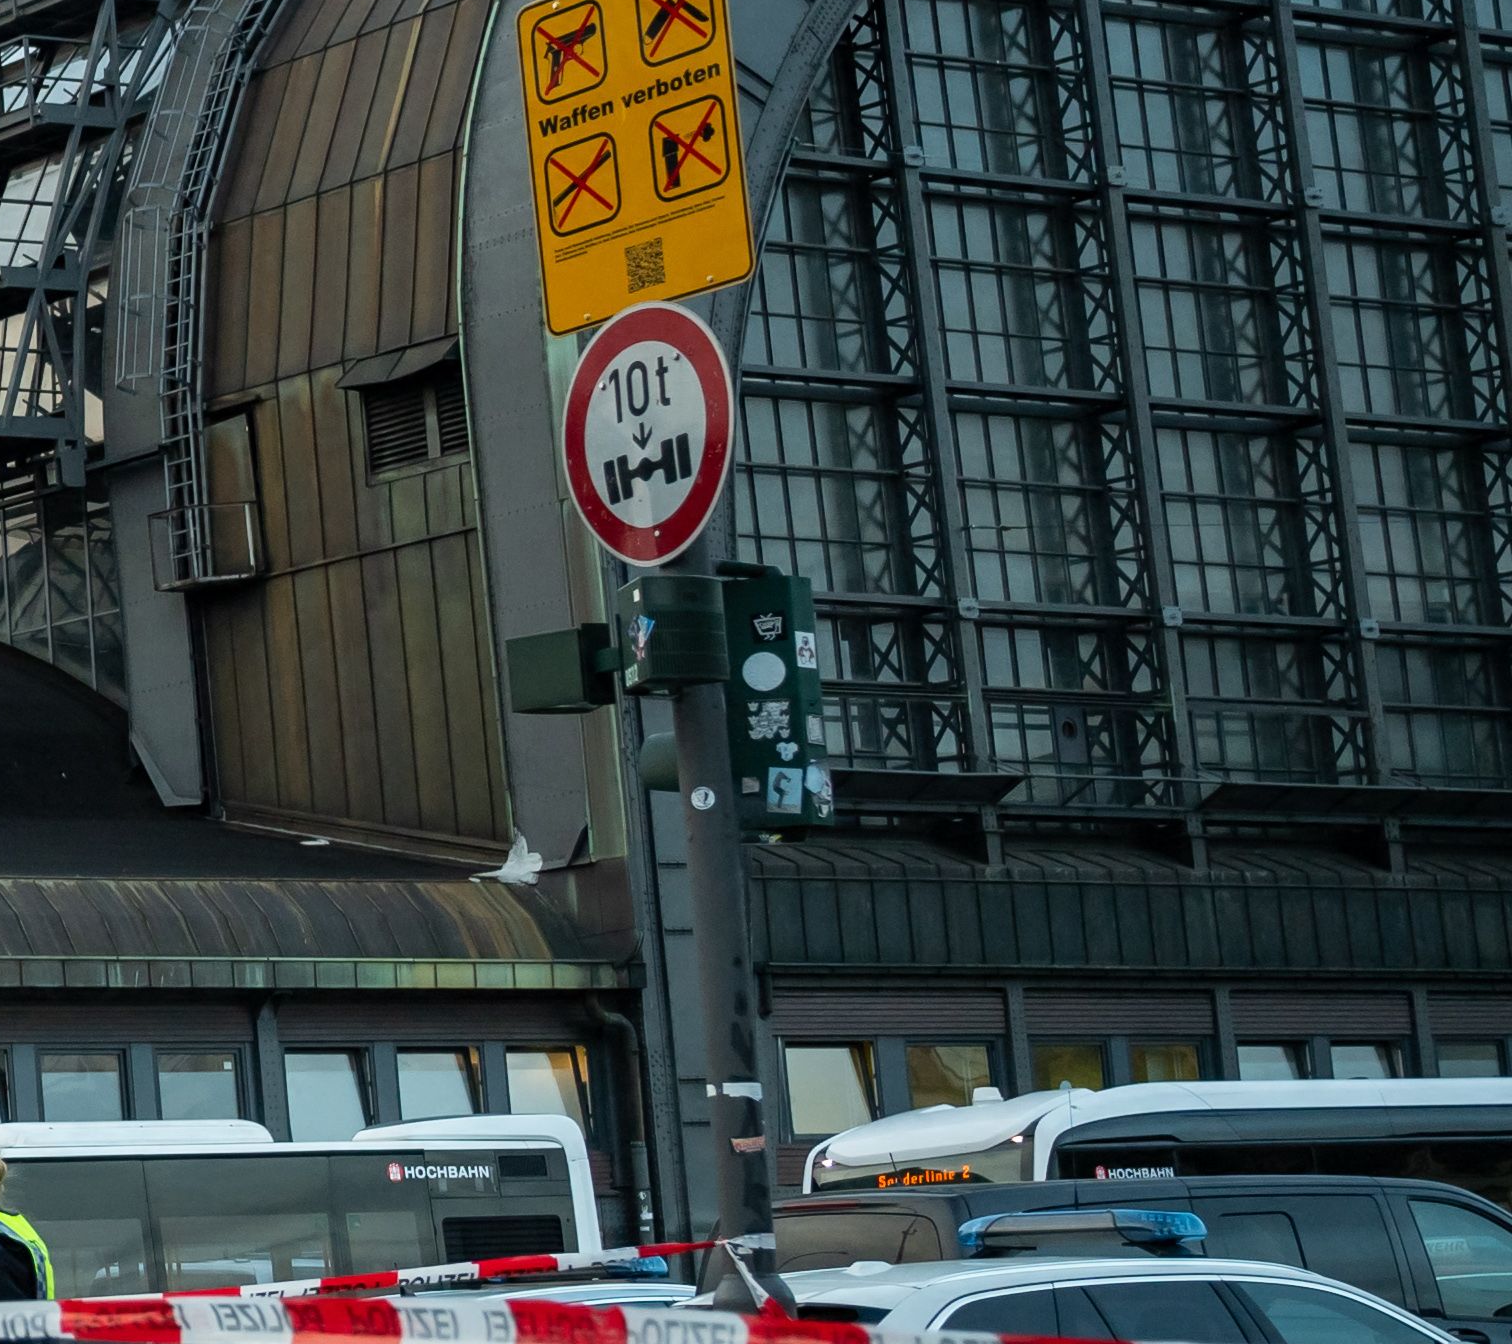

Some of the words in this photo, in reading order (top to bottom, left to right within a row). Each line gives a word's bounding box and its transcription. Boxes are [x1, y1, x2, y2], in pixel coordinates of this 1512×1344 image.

[538, 100, 615, 137] Waffen
[621, 63, 721, 109] verboten
[404, 1165, 490, 1179] HOCHBAHN
[962, 1164, 971, 1179] 2
[1108, 1167, 1174, 1180] HOCHBAHN
